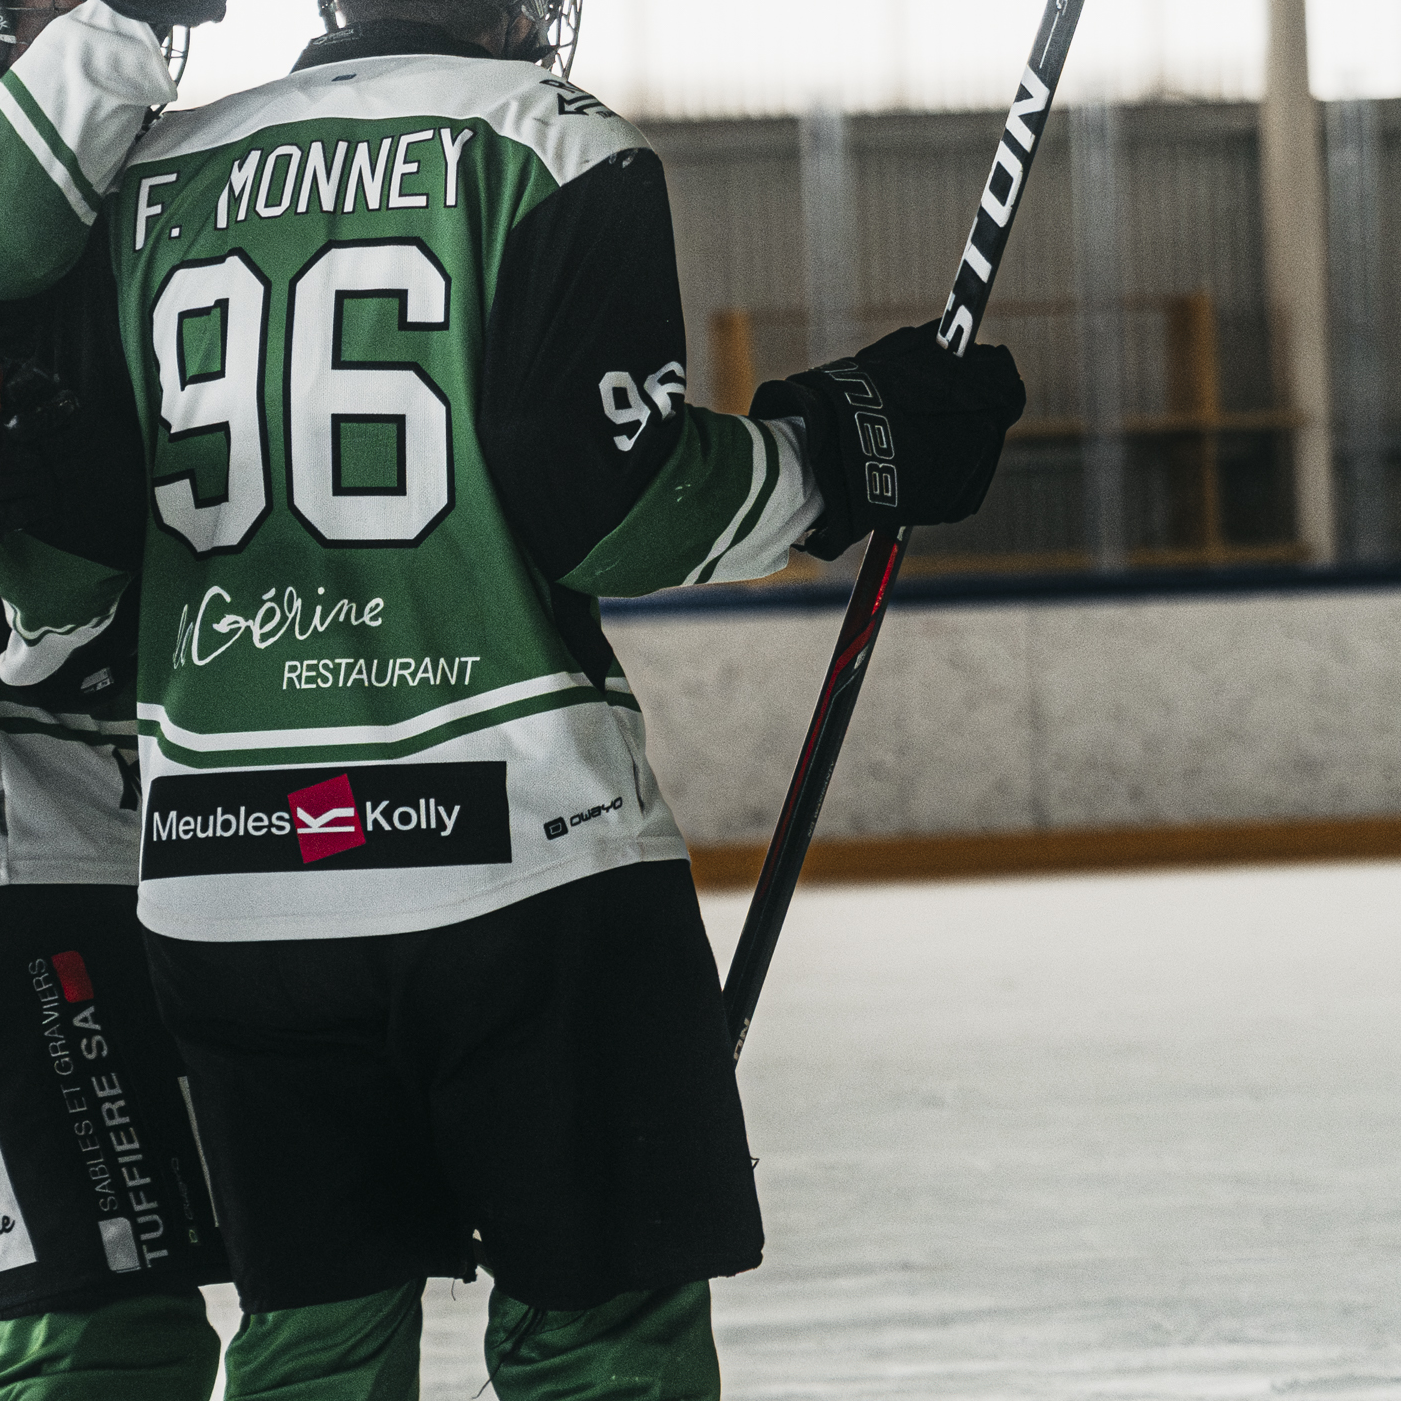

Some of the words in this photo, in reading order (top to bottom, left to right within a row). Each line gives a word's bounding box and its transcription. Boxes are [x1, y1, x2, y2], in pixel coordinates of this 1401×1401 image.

[133, 173, 182, 253] F.
[214, 127, 478, 231] MONNEY
[151, 238, 454, 559] 96
[282, 656, 481, 691] RESTAURANT
[151, 807, 291, 843] Meubles
[365, 798, 461, 837] Kolly
[28, 958, 75, 1076] GRAVIERS
[72, 1005, 108, 1060] SA
[61, 1083, 89, 1114] ET
[73, 1119, 118, 1212] SABLES
[91, 1072, 170, 1269] TUFFIERE
